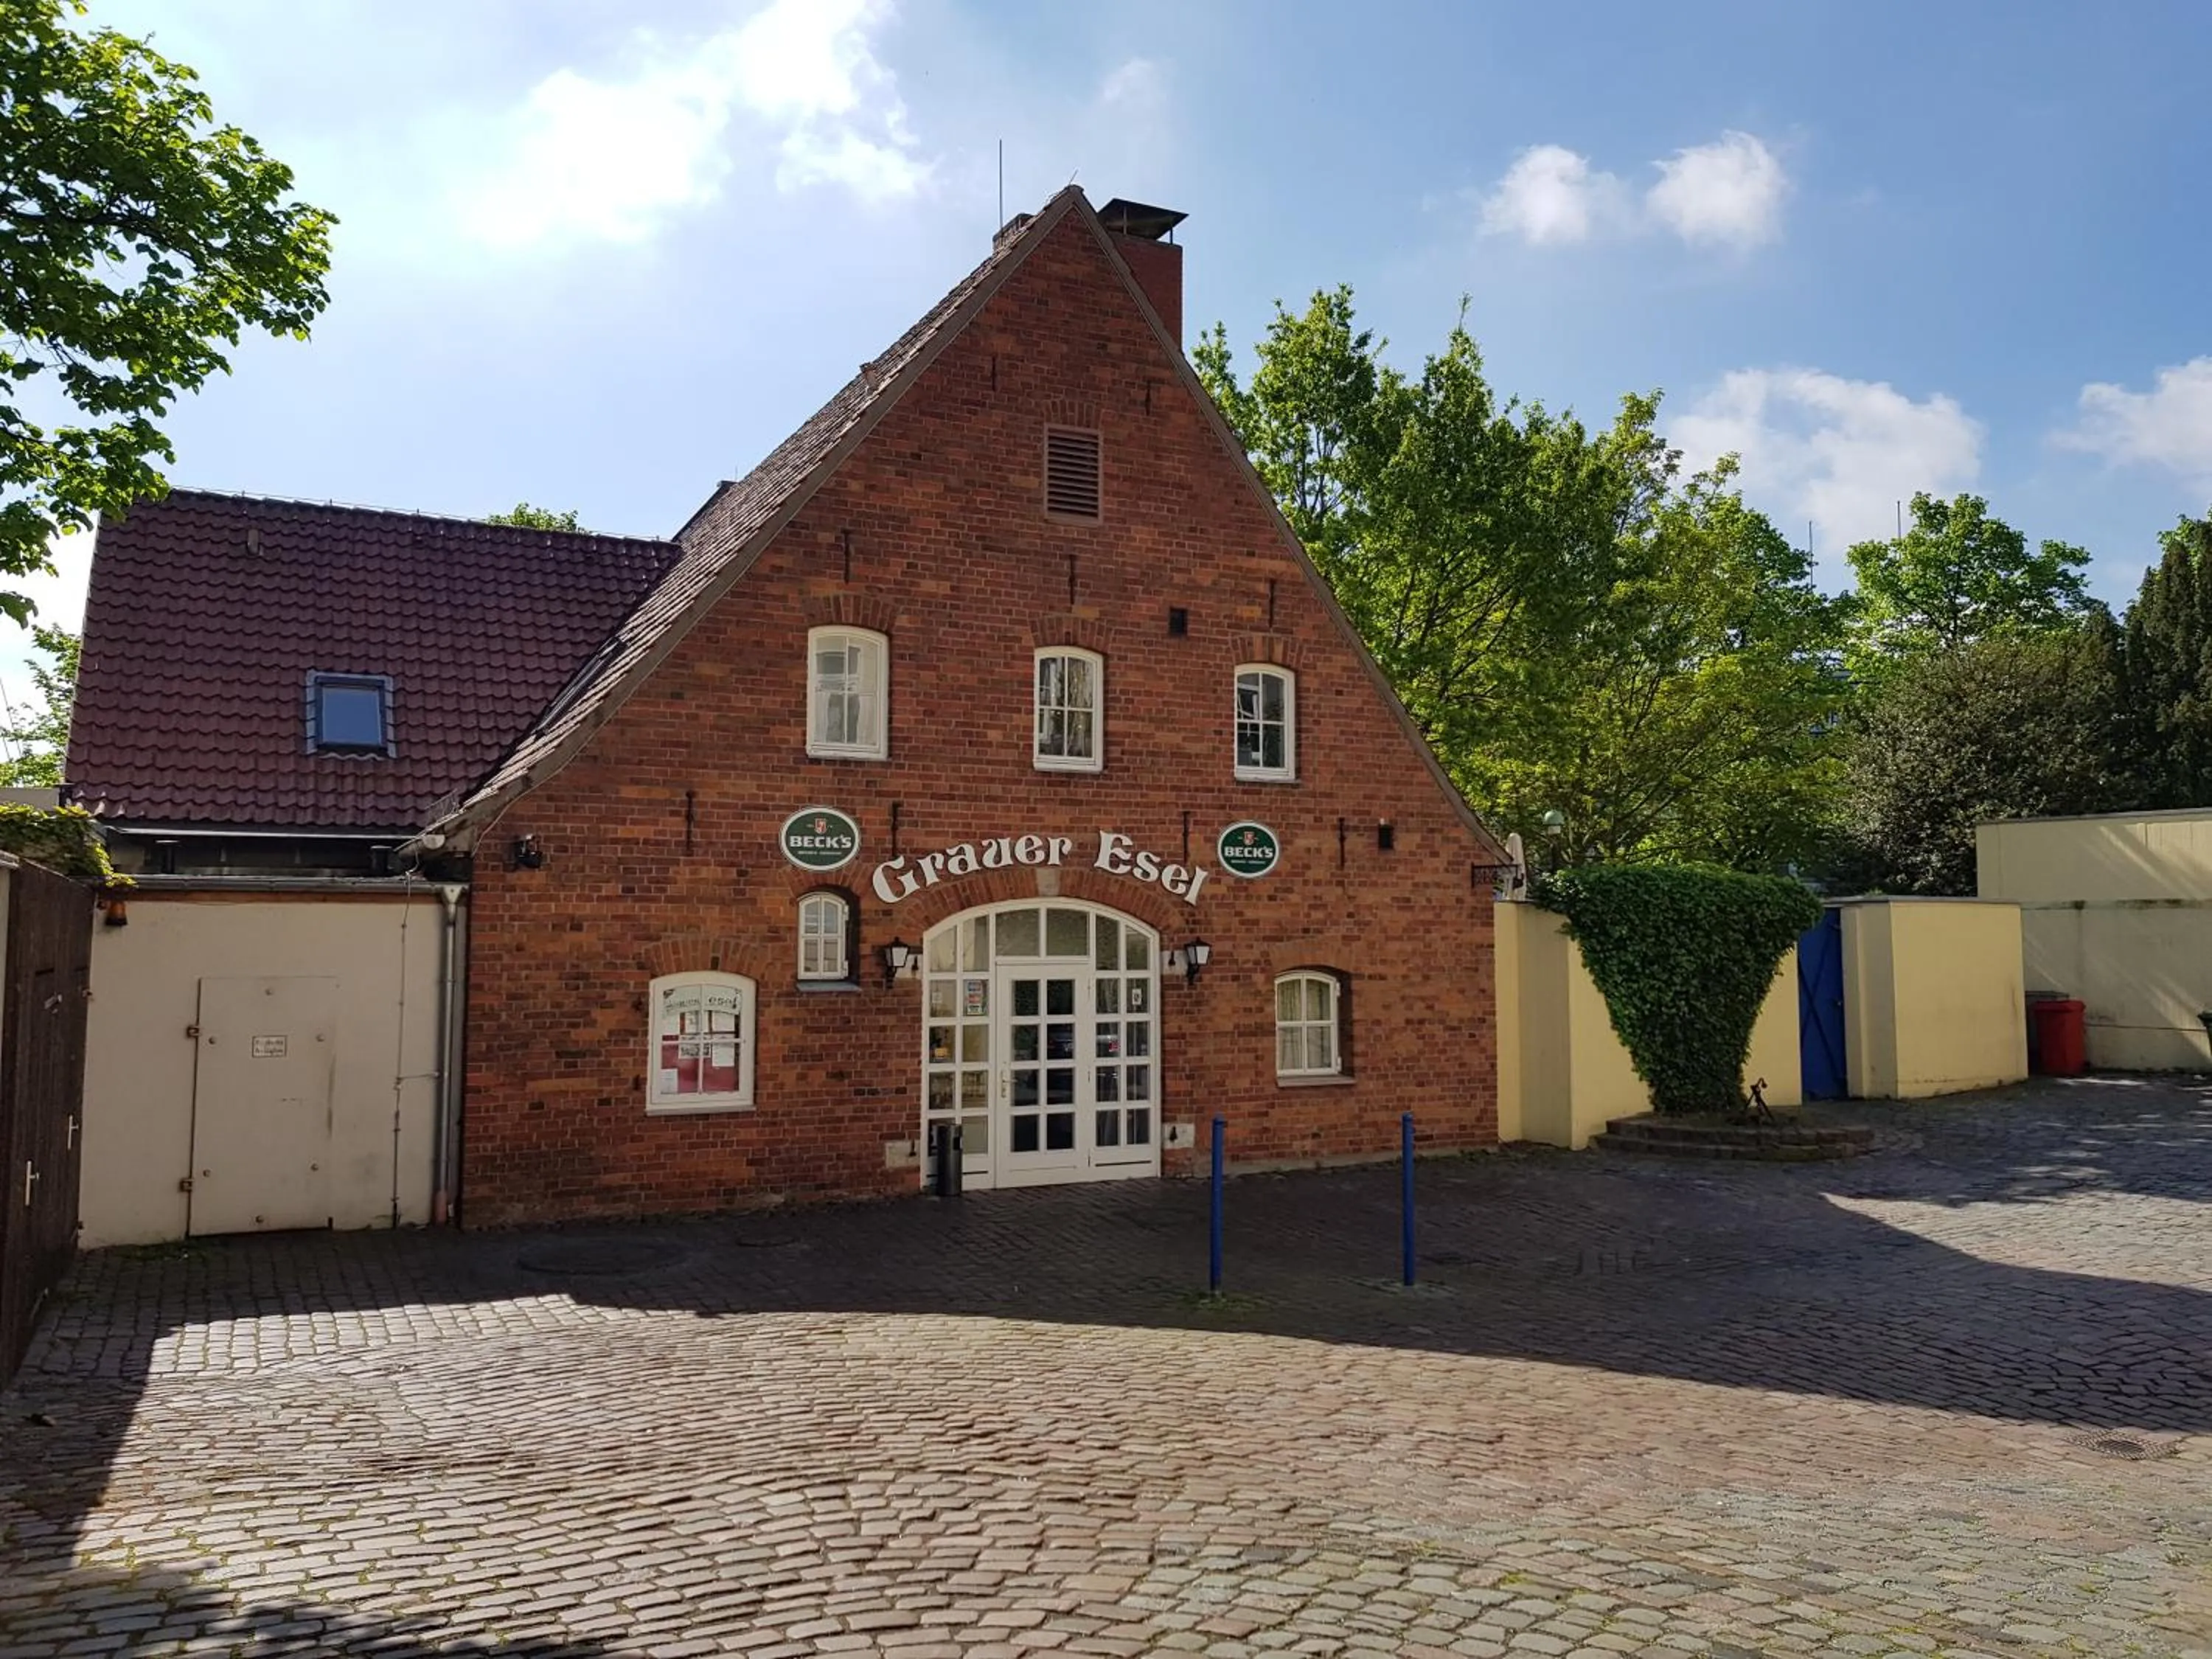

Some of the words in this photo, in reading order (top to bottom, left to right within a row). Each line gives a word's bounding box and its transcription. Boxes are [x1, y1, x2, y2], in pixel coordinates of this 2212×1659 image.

[789, 834, 852, 848] BECK'S
[1224, 846, 1273, 858] BECK'S
[872, 834, 1072, 904] Grauer
[1093, 830, 1208, 906] Esel
